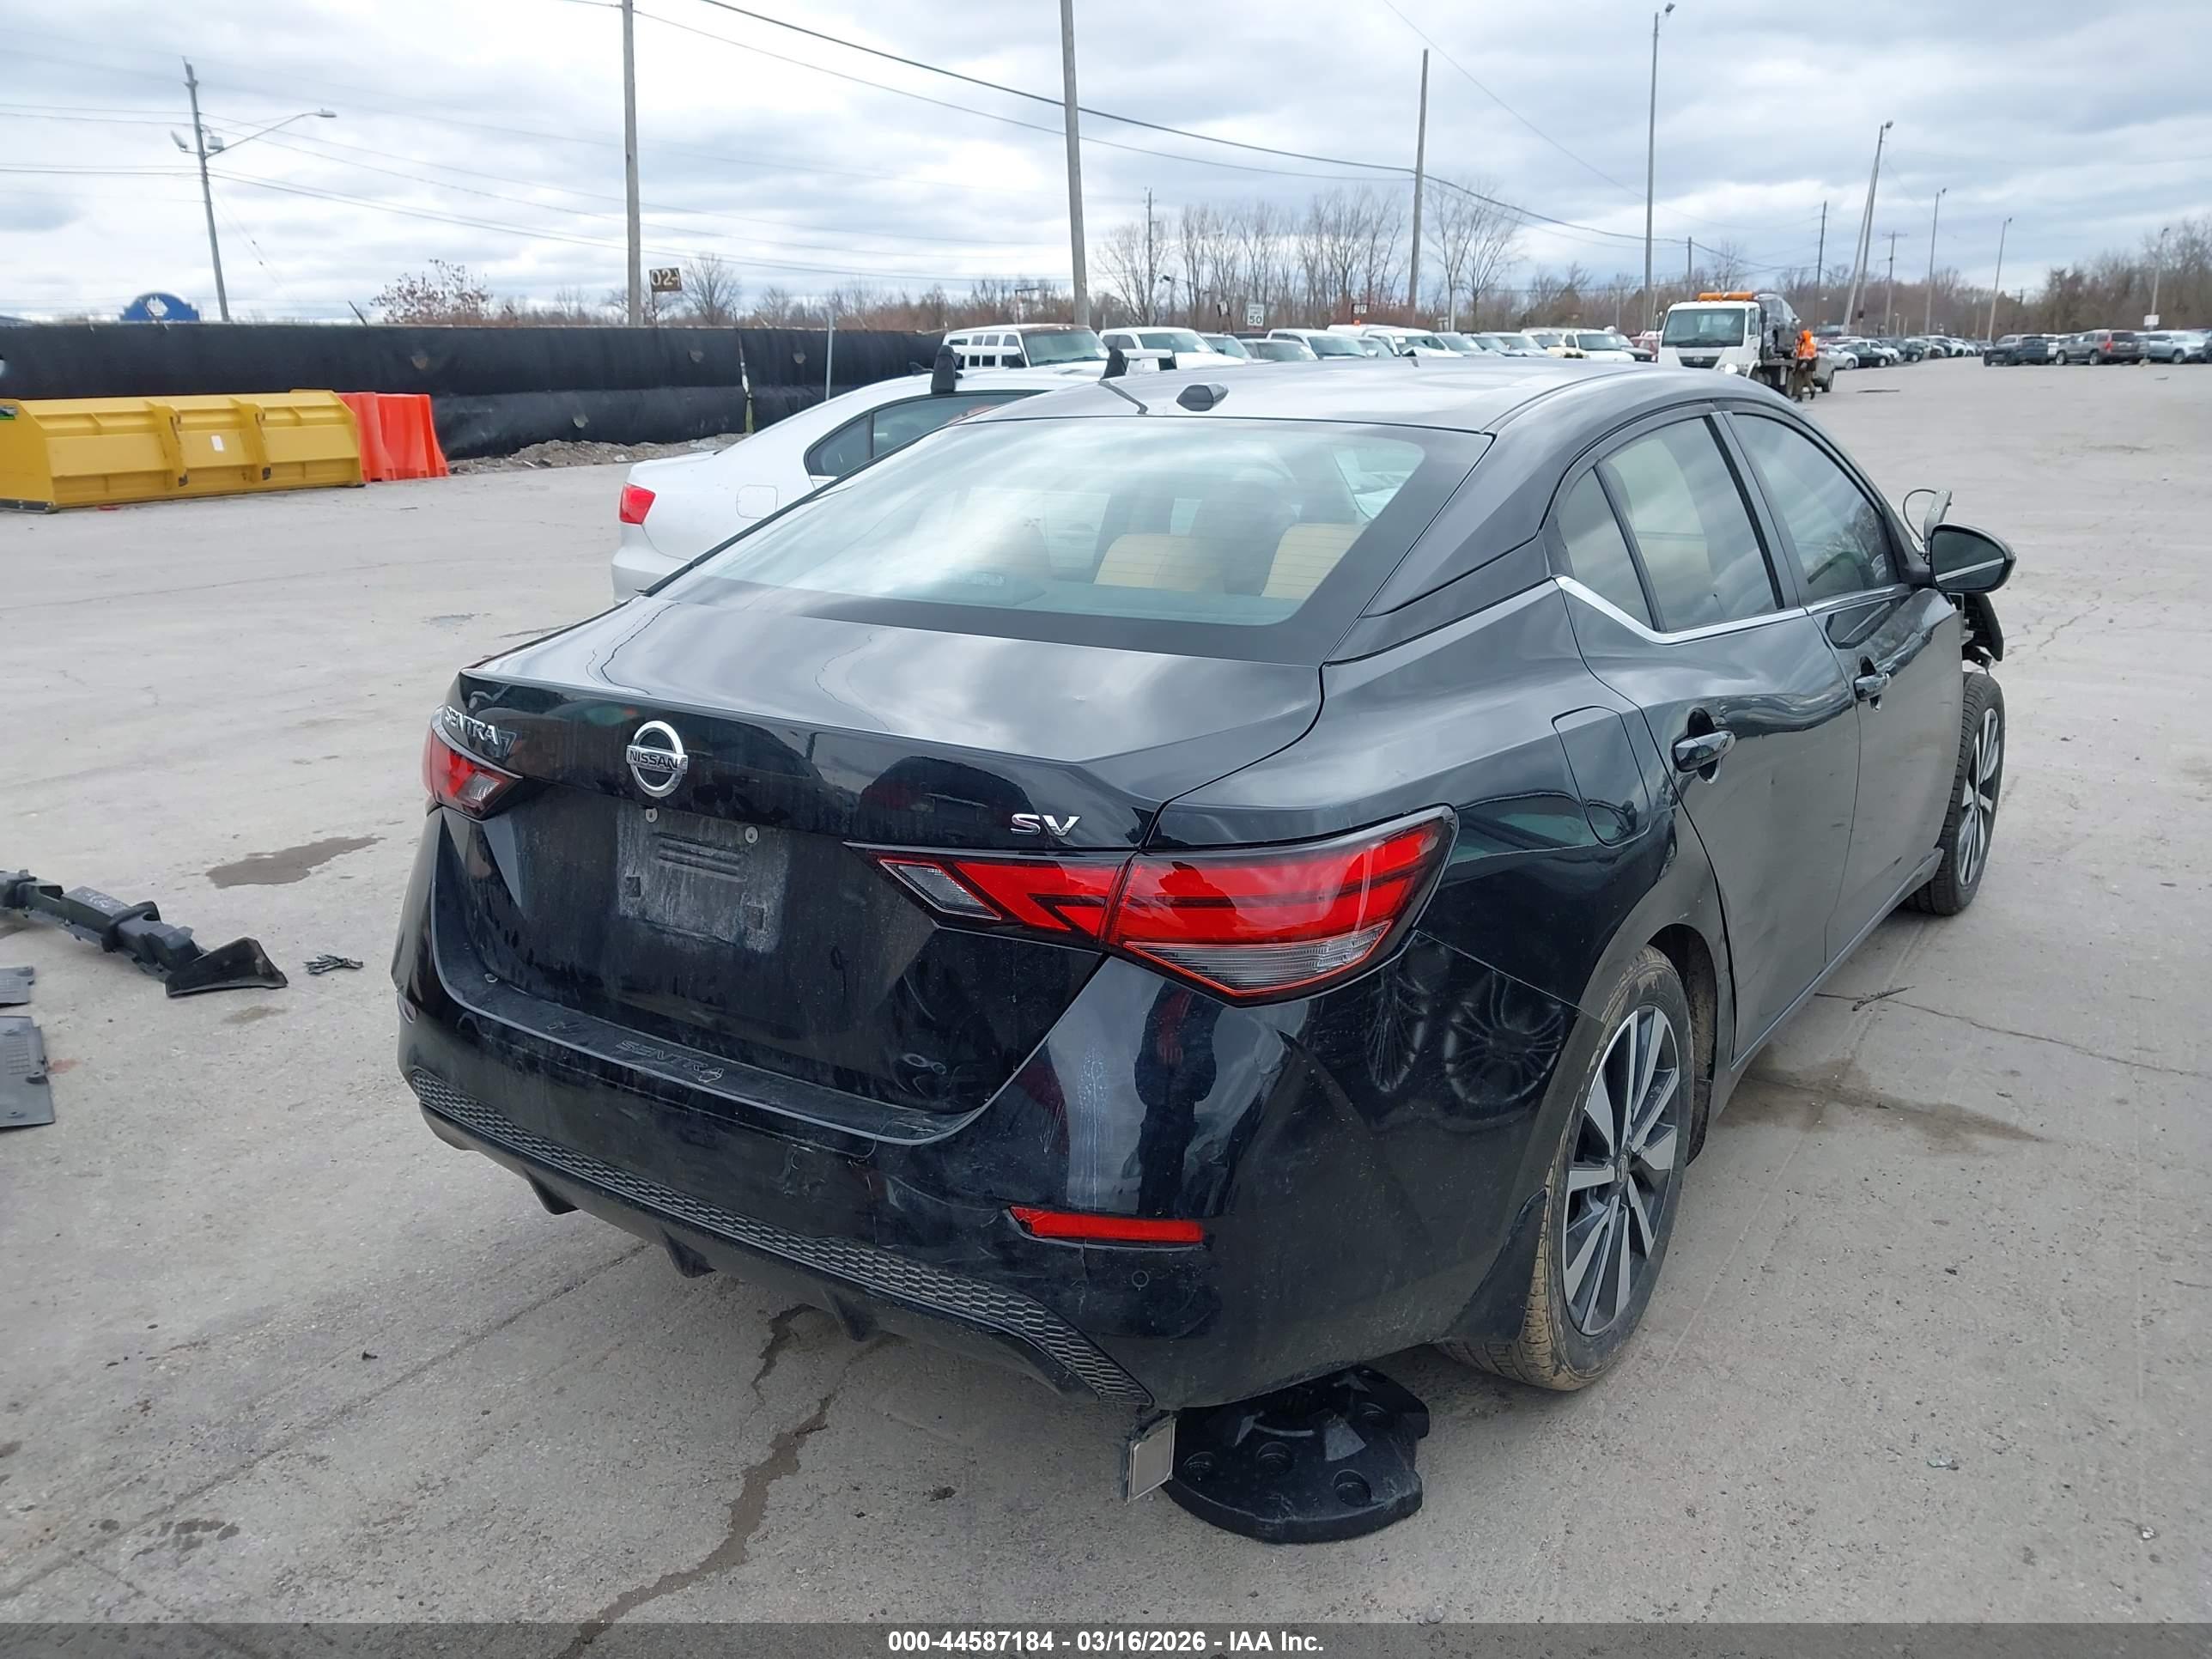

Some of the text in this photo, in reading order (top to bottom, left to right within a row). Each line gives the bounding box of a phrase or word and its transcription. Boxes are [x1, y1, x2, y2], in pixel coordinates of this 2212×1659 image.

[445, 706, 499, 745] SENTRA
[629, 750, 678, 769] NISSAN
[1011, 813, 1080, 836] SV
